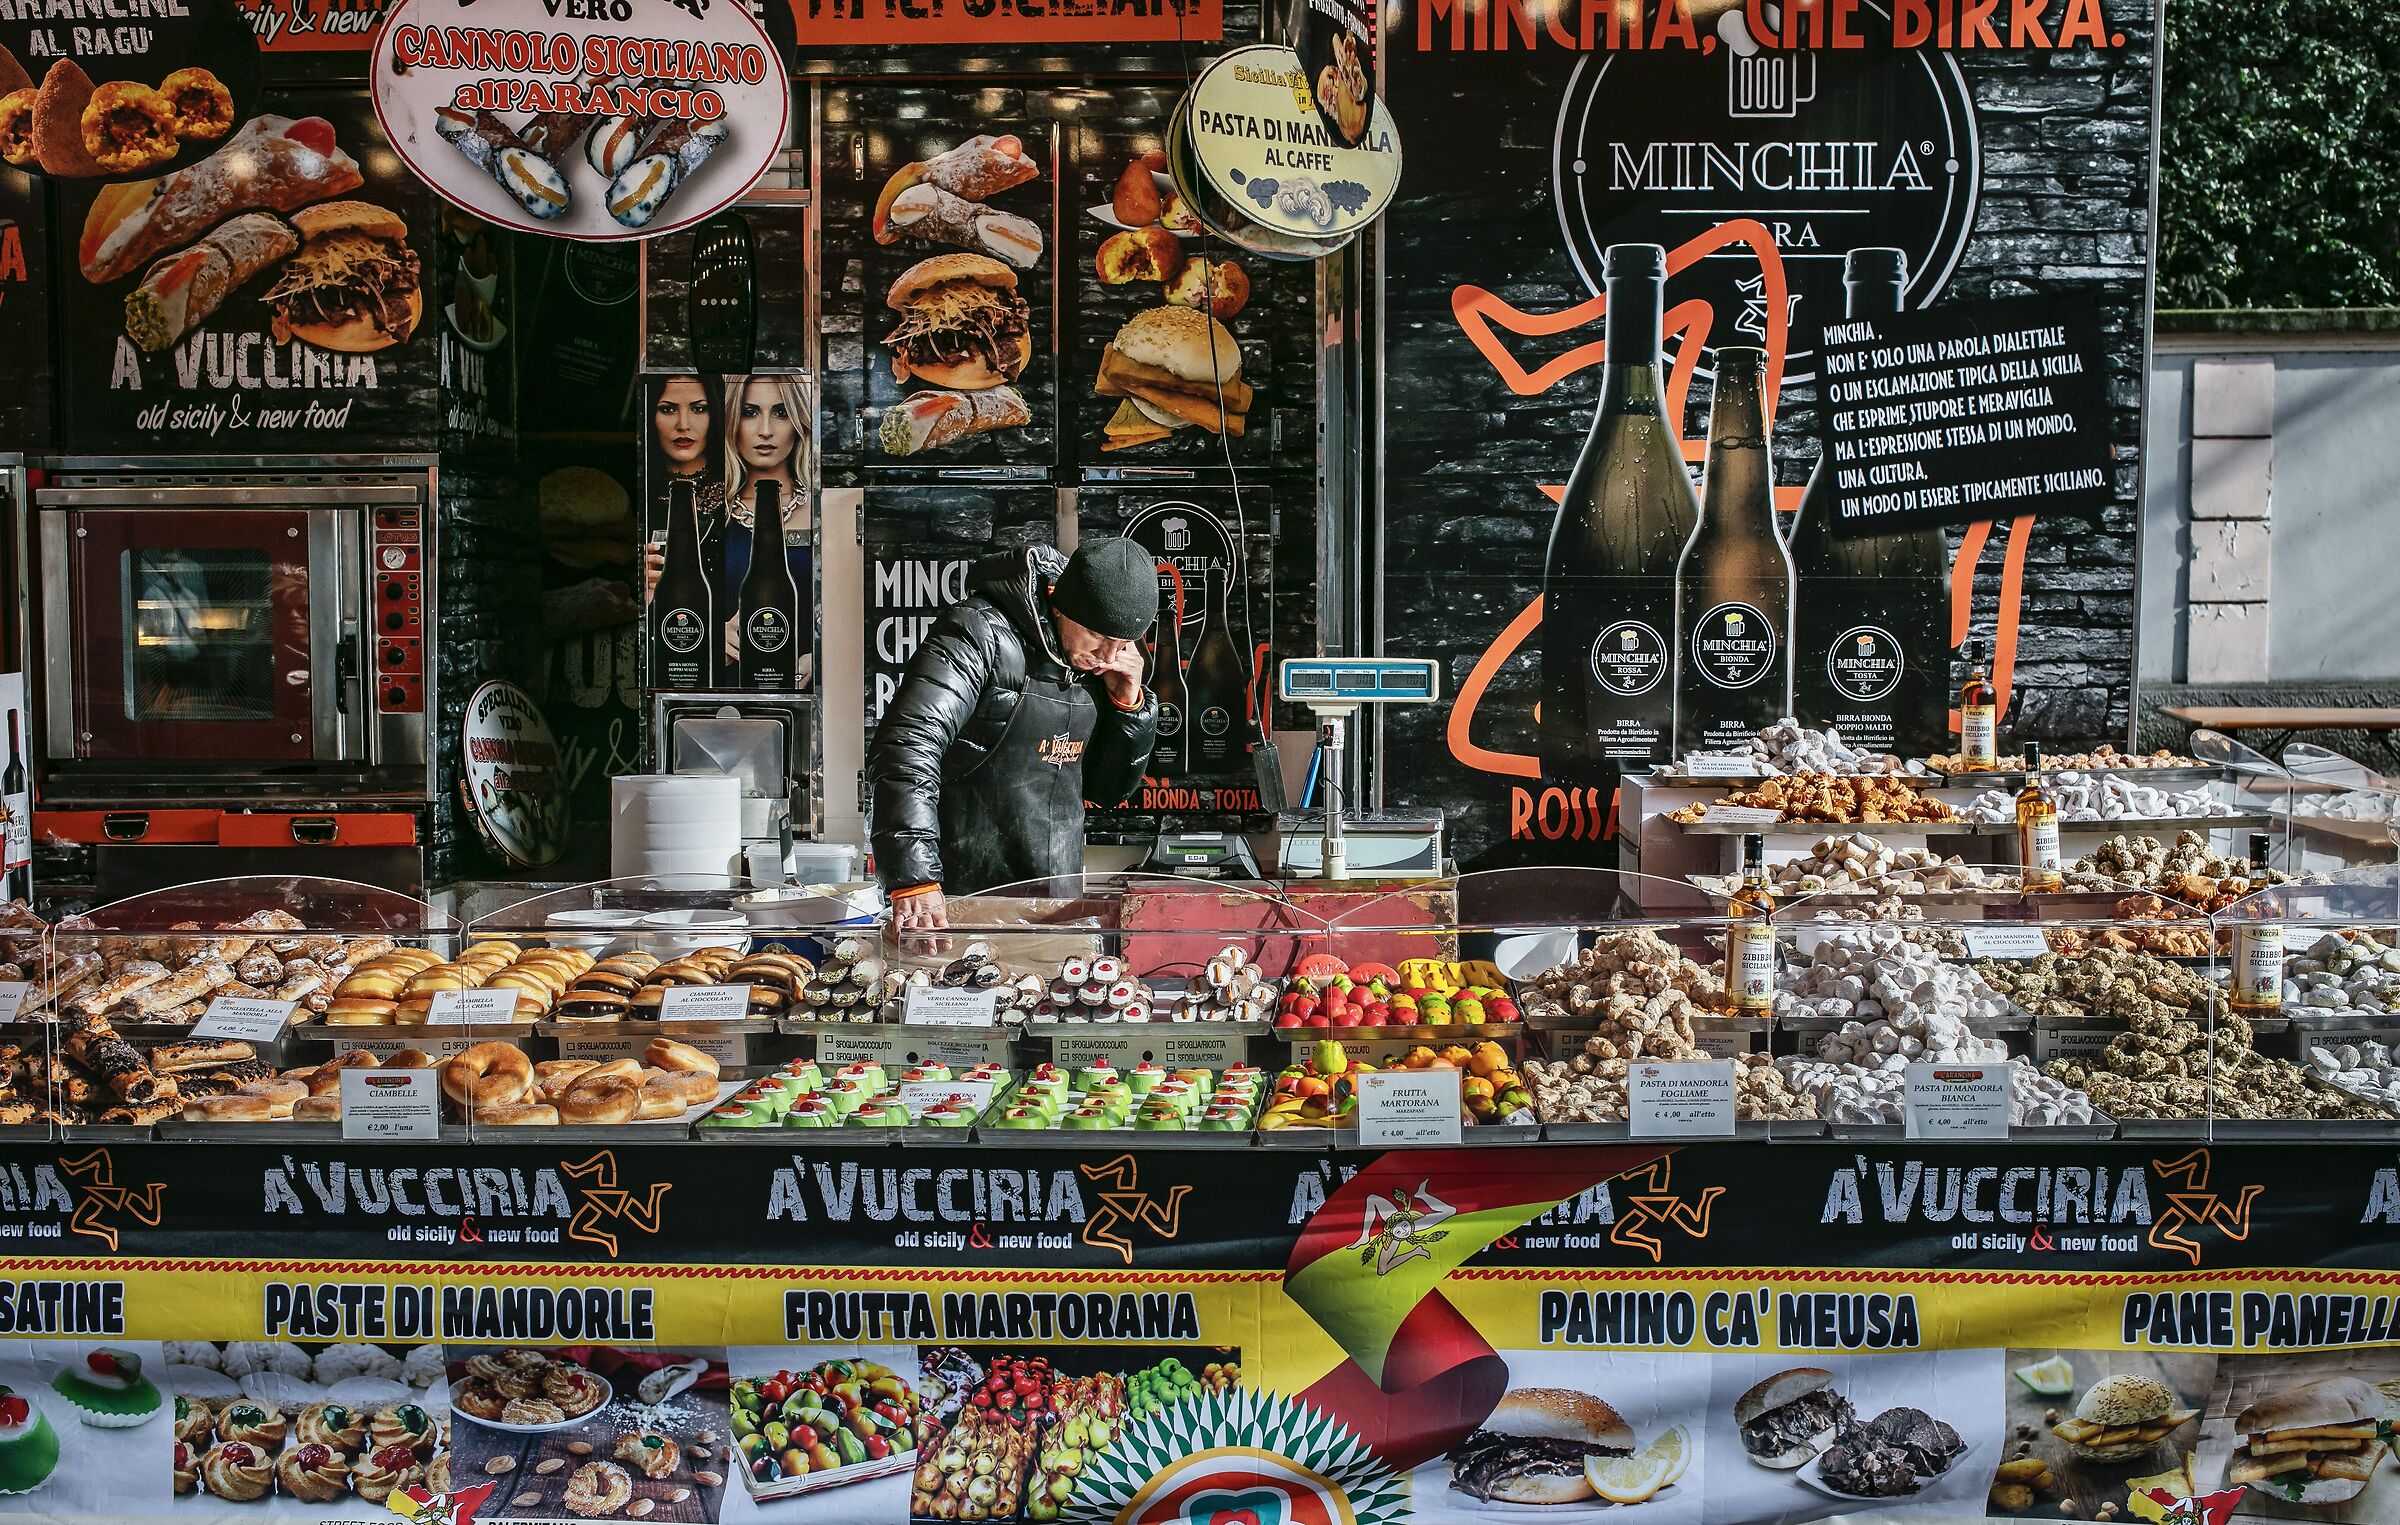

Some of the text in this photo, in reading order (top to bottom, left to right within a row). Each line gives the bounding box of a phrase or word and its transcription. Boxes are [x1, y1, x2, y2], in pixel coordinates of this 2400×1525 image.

[542, 0, 633, 21] VERO
[1416, 0, 2126, 57] MINCHIA, CHE BIRRA.
[30, 26, 153, 56] AL RAGU'
[394, 25, 766, 84] CANNOLO SICILIANO
[455, 77, 726, 120] all'ARANCIO
[1200, 110, 1260, 139] PASTA
[1264, 118, 1282, 142] DI
[1265, 148, 1334, 171] AL CAFFE'
[1826, 353, 1855, 374] NON
[1873, 347, 1904, 370] SOLO
[1907, 343, 1934, 365] UNA
[1938, 336, 1990, 360] PAROLA
[1993, 326, 2065, 354] DIALETTALE
[1830, 353, 2083, 403] O UN ESCLAMAZIONE TIPICA DELLA SICILIA
[136, 392, 352, 438] old sicily & new food
[1833, 410, 1856, 432] CHE
[1858, 404, 1907, 429] ESPRIME
[1968, 395, 1976, 415] E
[1979, 387, 2053, 415] MERAVIGLIA
[1835, 413, 2077, 461] MA L'ESPRESSIONE STESSA DI UN MONDO,
[1838, 461, 1928, 489] UNA CULTURA,
[1841, 467, 2106, 518] UN MODO DI ESSERE TIPICAMENTE SICILIANO.
[666, 626, 699, 634] MINCHIA
[1720, 720, 1745, 728] BIRRA
[1861, 714, 1892, 722] BIONDA
[1616, 736, 1658, 744] Agroalimentare
[1143, 789, 1200, 810] BIONDA
[1214, 789, 1260, 810] TOSTA
[1511, 787, 1620, 840] ROSSA
[219, 1005, 263, 1013] SFOGLIATELLA
[457, 997, 493, 1005] CIAMBELLA
[232, 1010, 268, 1018] MANDORLA
[577, 1042, 631, 1050] SFOGLIA/CIOCCOLATO
[836, 1041, 891, 1049] SFOGLIA/CIOCCOLATO
[1071, 1040, 1128, 1050] SFOGLIA/CIOCCOLATO
[1177, 1040, 1226, 1049] SFOGLIA/RICOTTA
[2322, 1035, 2382, 1045] SFOGLIA/CIOCCOLATO
[836, 1053, 873, 1061] SFOGLIA/MELE
[1177, 1053, 1223, 1062] SFOGLIA/CREMA
[1380, 1099, 1440, 1108] MARTORANA
[1392, 1089, 1427, 1097] FRUTTA
[1690, 1110, 1715, 1118] all'etto
[387, 1216, 559, 1247] old sicily & new food
[894, 1222, 1073, 1252] old sicily & new food
[1495, 1233, 1600, 1250] & new food
[1951, 1223, 2139, 1254] old sicily & new food
[263, 1281, 656, 1342] PASTE DI MANDORLE
[782, 1289, 1201, 1342] FRUTTA MARTORANA
[1538, 1286, 1921, 1351] PANINO CA' MEUSA
[2121, 1290, 2235, 1347] PANE
